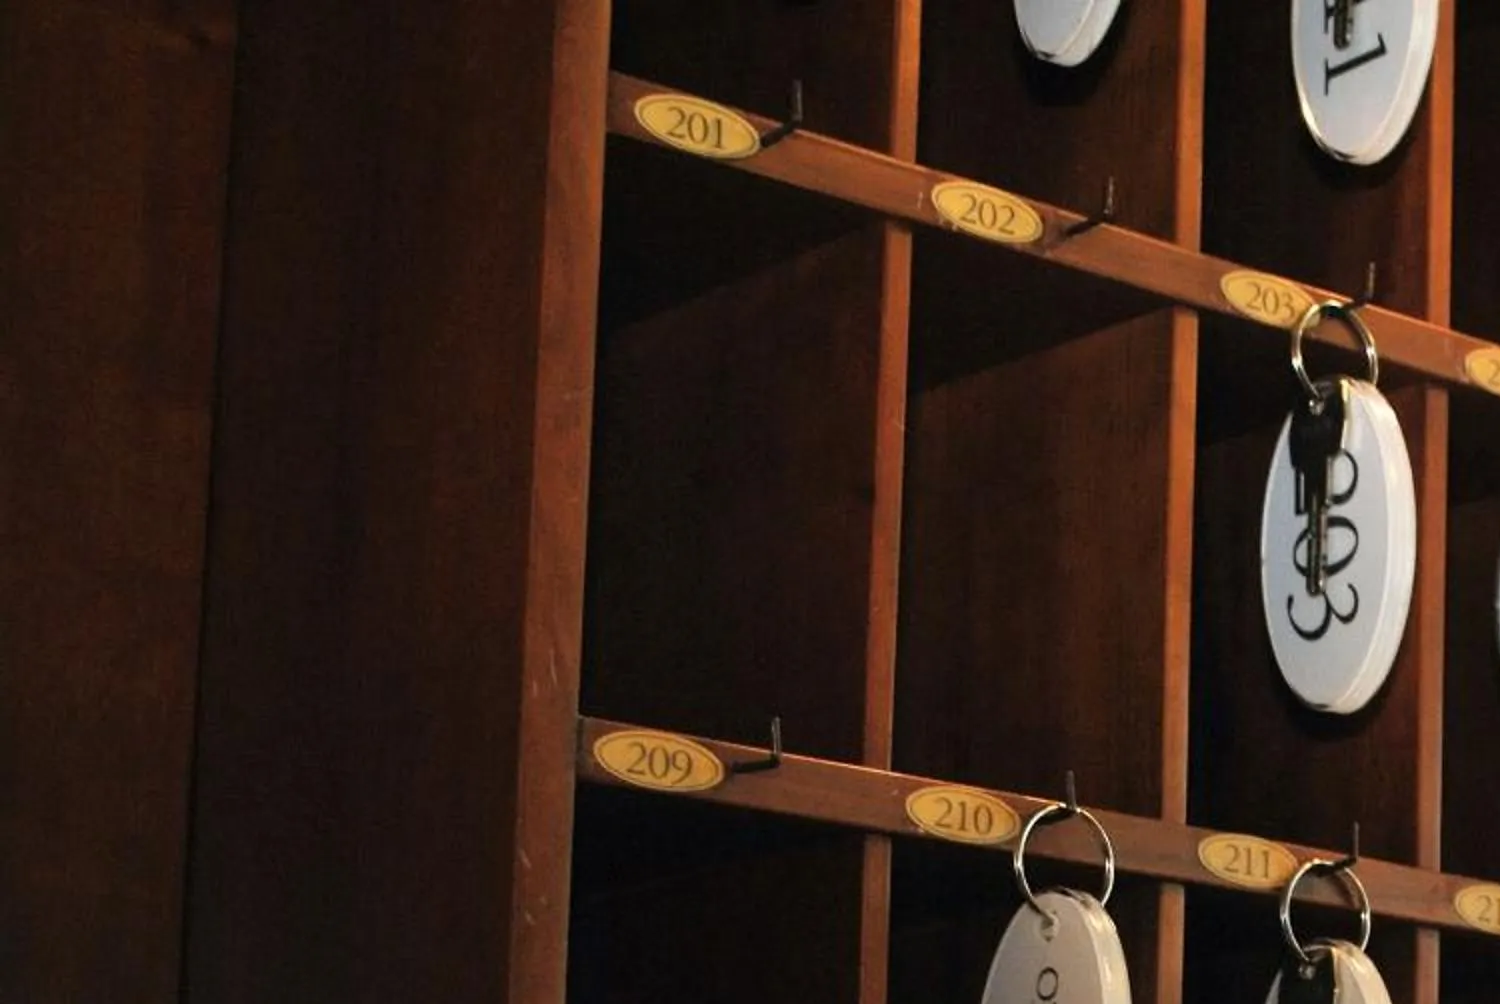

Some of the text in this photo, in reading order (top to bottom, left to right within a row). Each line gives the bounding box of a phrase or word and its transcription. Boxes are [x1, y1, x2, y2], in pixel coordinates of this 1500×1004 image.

[666, 106, 728, 150] 201
[957, 192, 1018, 235] 202
[1245, 283, 1297, 319] 203
[625, 741, 693, 786] 209
[934, 796, 993, 837] 210
[1223, 843, 1272, 879] 211
